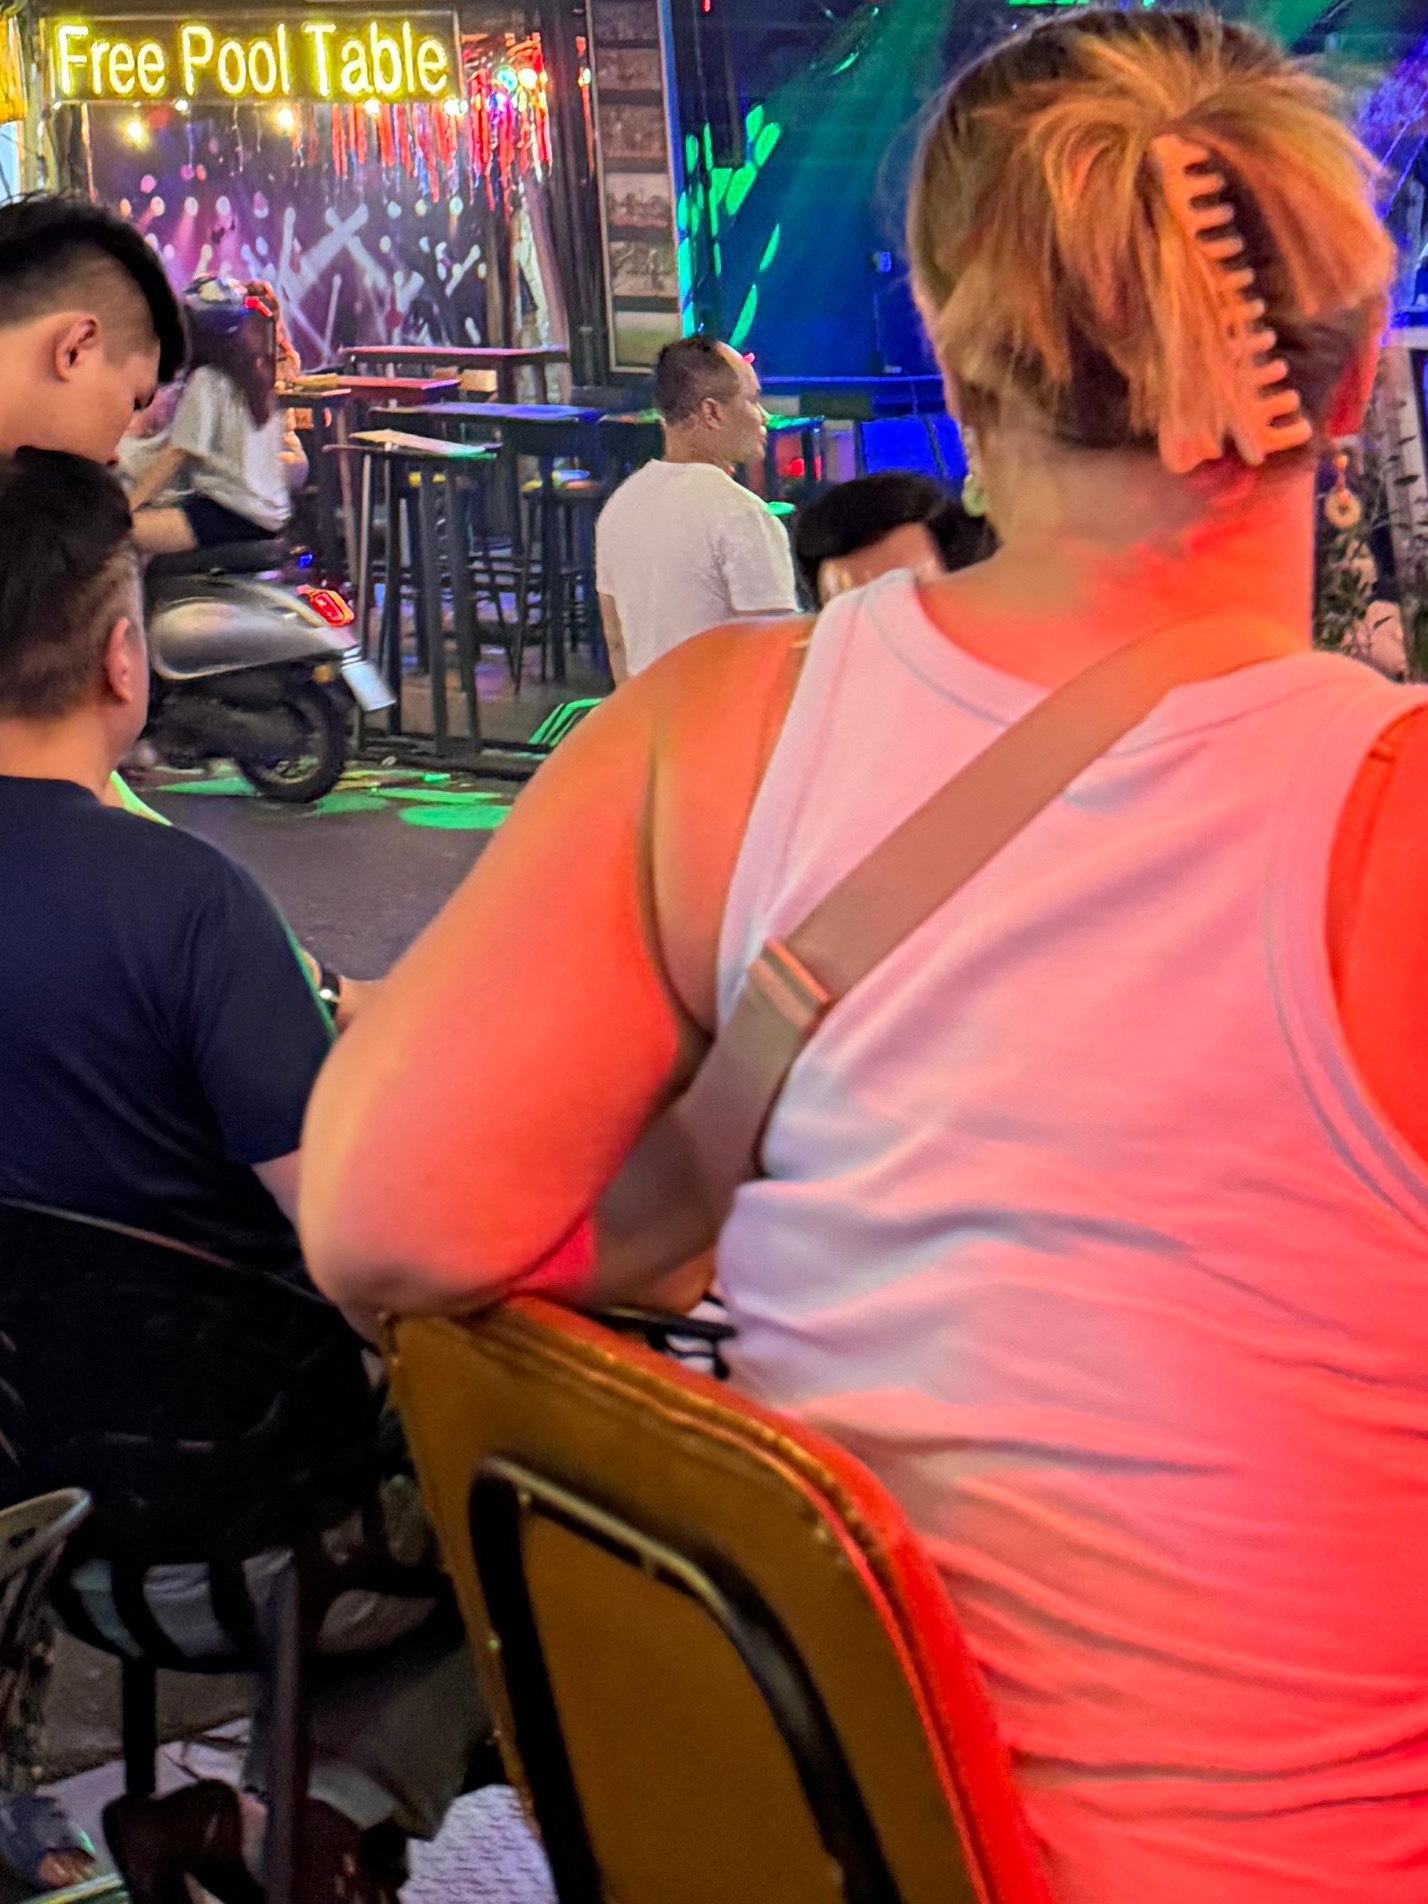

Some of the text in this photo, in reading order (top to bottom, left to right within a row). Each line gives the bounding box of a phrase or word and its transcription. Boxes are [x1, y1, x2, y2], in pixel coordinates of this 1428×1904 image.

[57, 20, 447, 97] Free Pool Table
